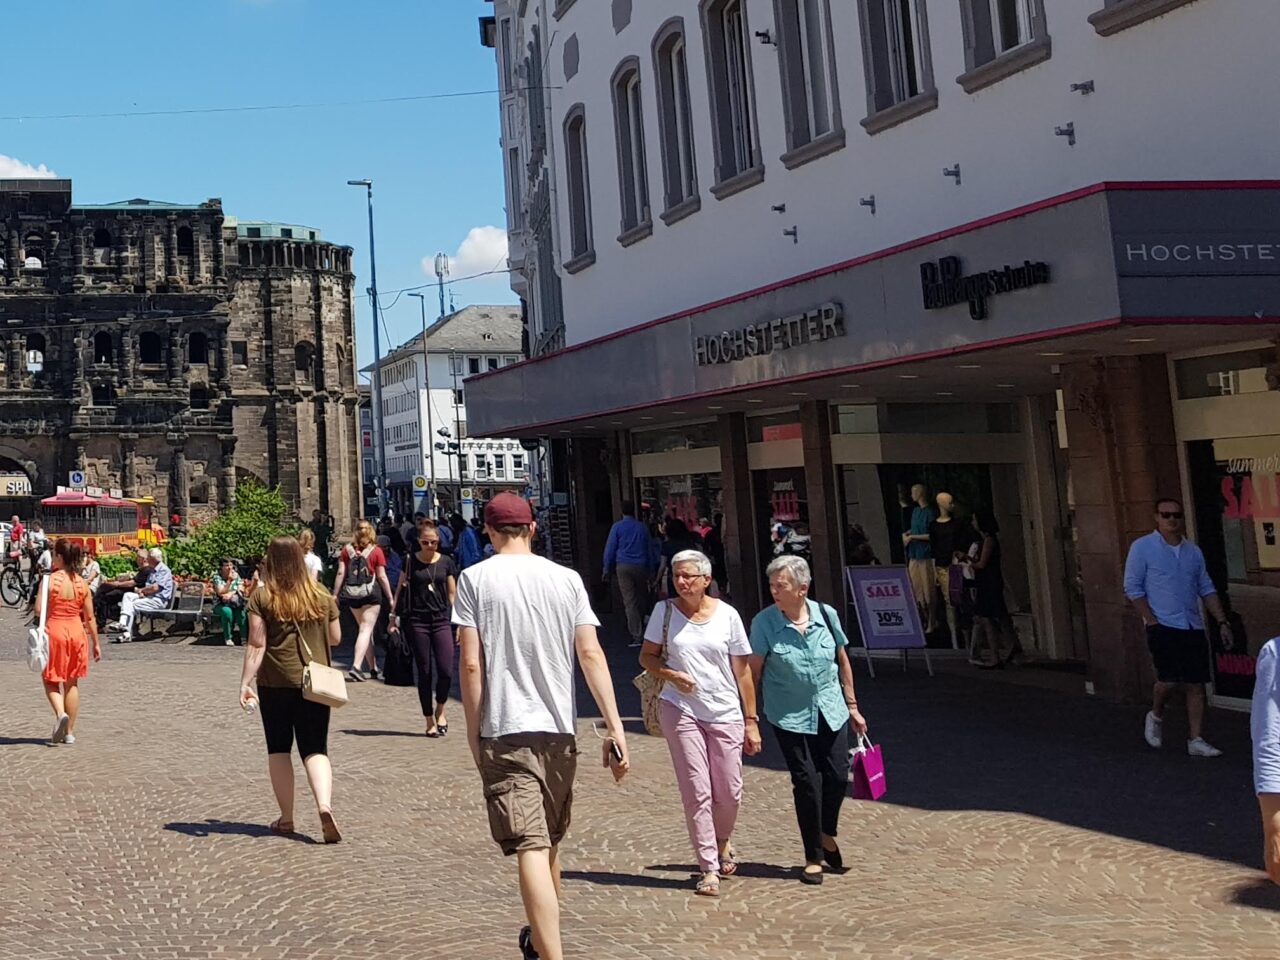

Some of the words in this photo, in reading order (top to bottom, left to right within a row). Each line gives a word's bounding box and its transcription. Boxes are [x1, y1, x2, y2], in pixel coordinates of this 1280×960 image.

[1126, 243, 1280, 261] HOCHSTE
[694, 300, 846, 367] HOCHSTETTER
[1221, 472, 1280, 519] SAL
[866, 585, 901, 598] SALE
[876, 612, 903, 623] 30%
